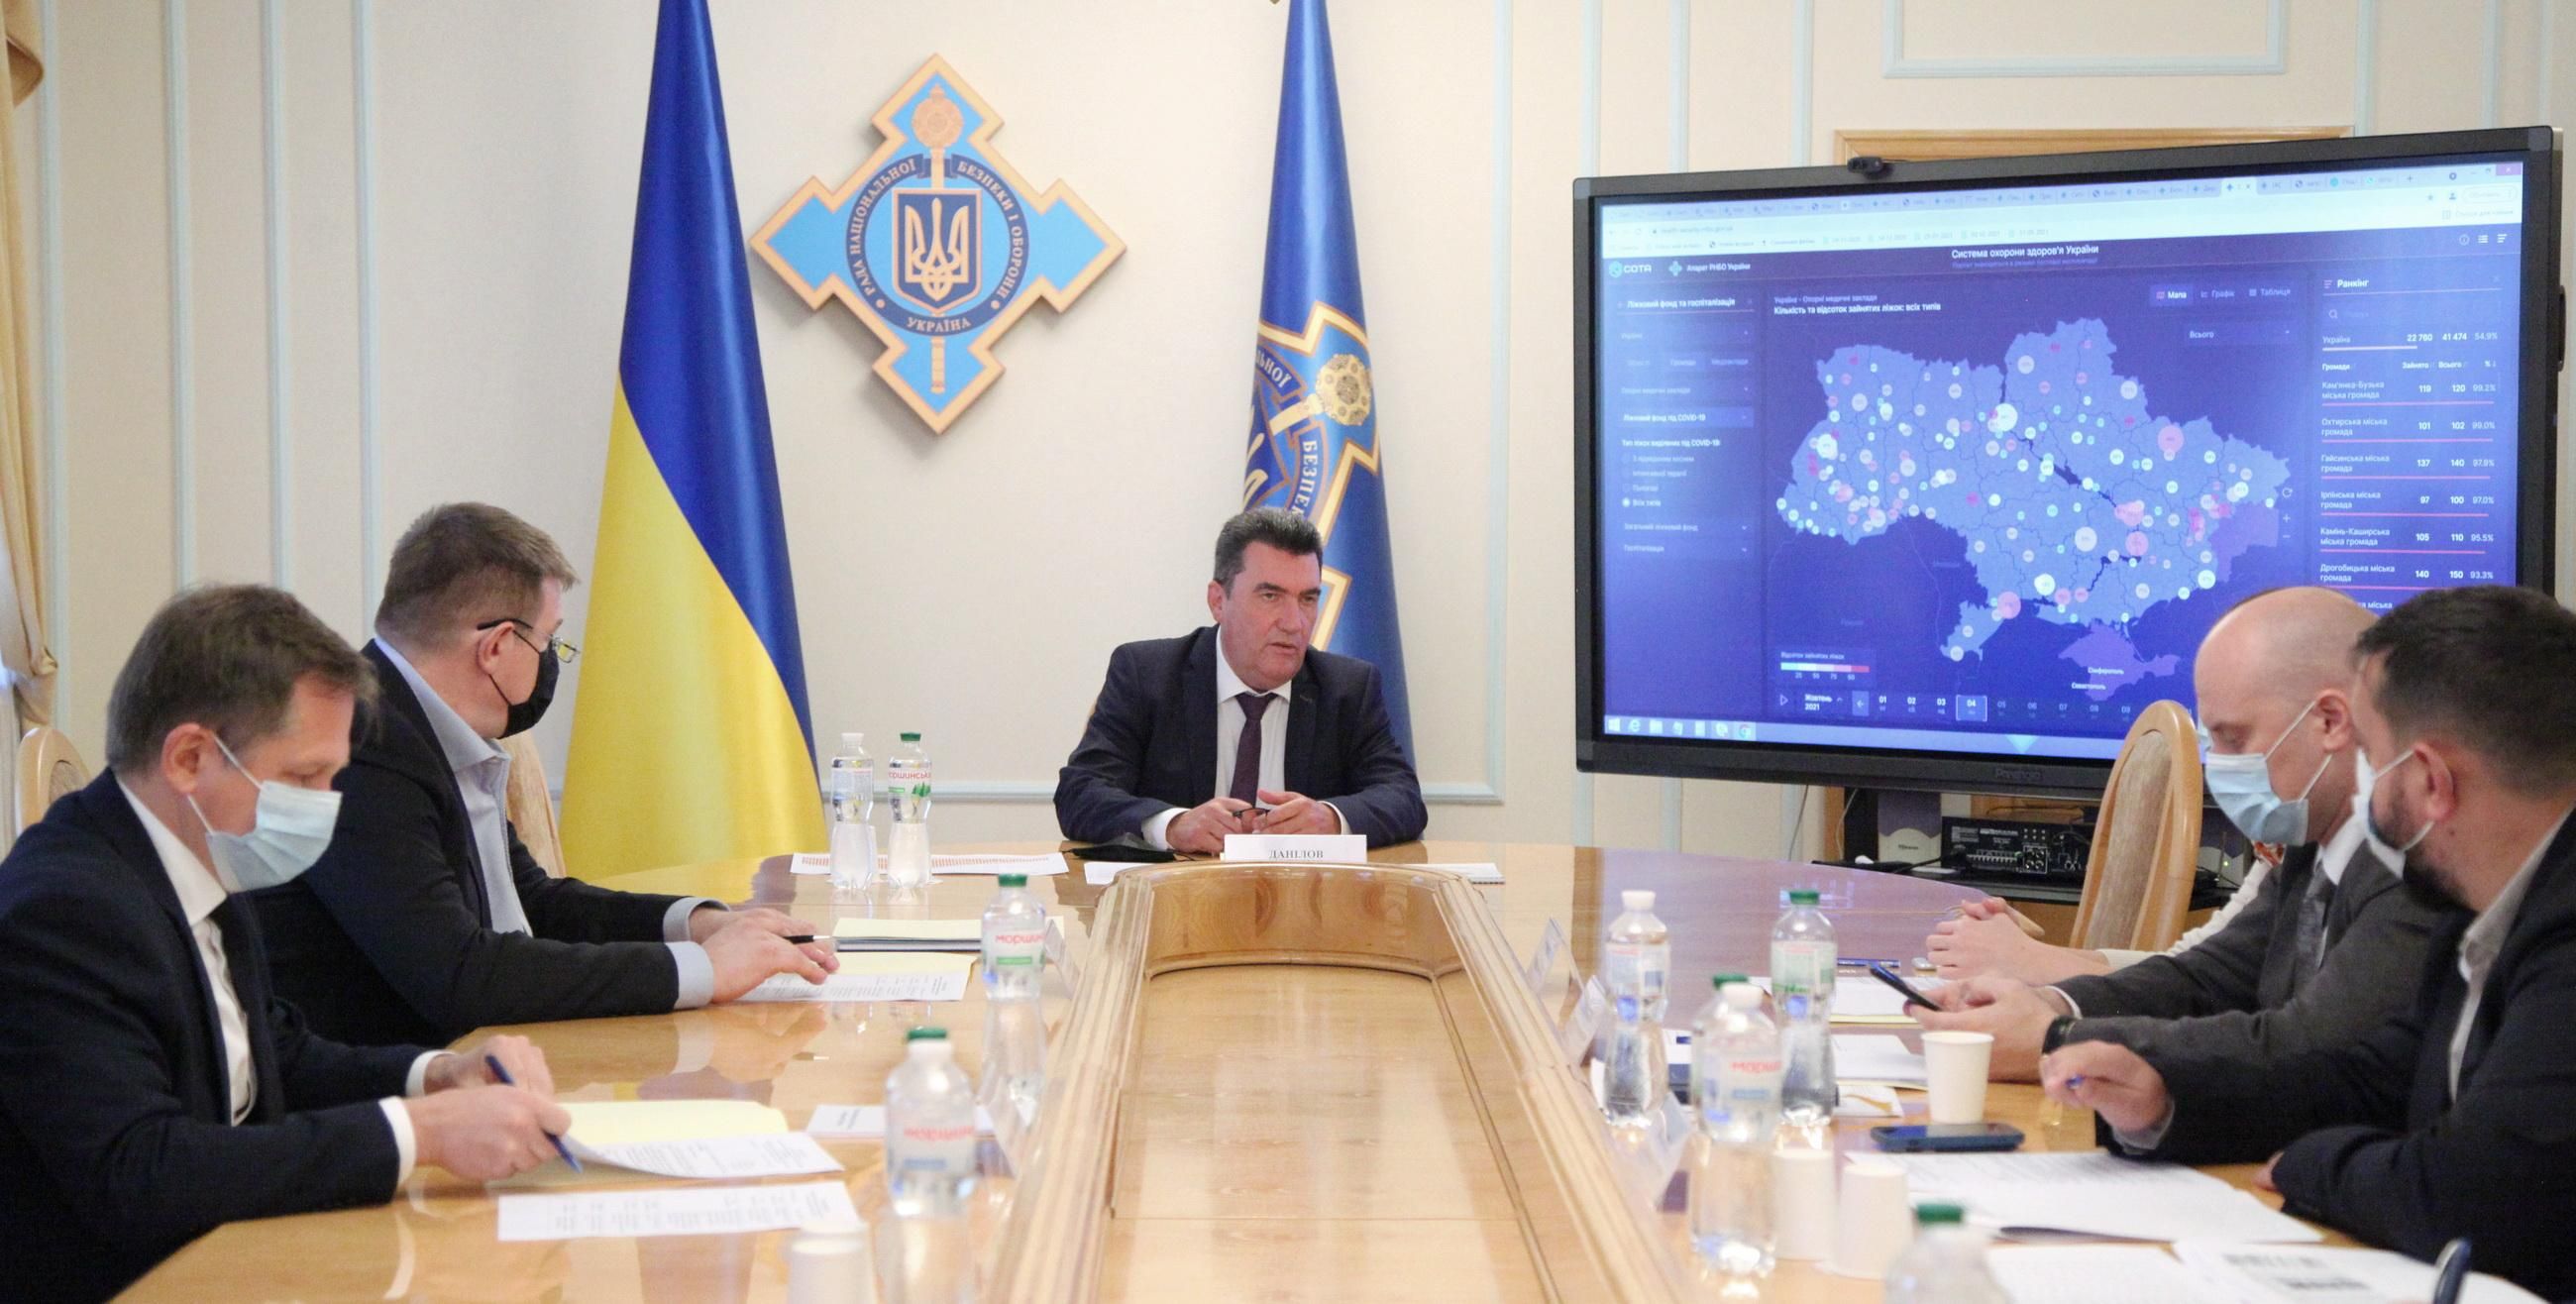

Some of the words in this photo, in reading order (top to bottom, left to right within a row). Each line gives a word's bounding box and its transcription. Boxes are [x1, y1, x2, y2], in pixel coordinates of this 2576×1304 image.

[956, 161, 1016, 211] БЕЗПЕКИ
[849, 158, 916, 256] НАЦІОНАЛЬНОЇ
[1951, 249, 1988, 260] Система
[1989, 249, 2025, 259] охорони
[2026, 246, 2064, 258] здоров'я
[2066, 244, 2099, 256] України
[997, 225, 1024, 299] ОБОРОНИ
[852, 260, 877, 296] РАДА
[2336, 278, 2369, 288] Ранкінг
[2260, 288, 2291, 297] Таблиця
[1660, 299, 1677, 309] фонд
[1773, 305, 1806, 315] Кількість
[1816, 304, 1848, 315] відсоток
[1848, 304, 1880, 313] зайнятих
[1905, 302, 1920, 311] всіх
[1922, 301, 1941, 311] типів
[906, 316, 972, 333] УКРАЇНА
[2189, 330, 2214, 339] Всього
[2322, 335, 2351, 344] Україна
[2347, 391, 2380, 400] громада
[2321, 417, 2361, 426] Охтирська
[2418, 421, 2431, 430] 101
[2451, 421, 2465, 430] 102
[2321, 428, 2353, 437] громада
[2320, 454, 2364, 463] Гайсинська
[2320, 465, 2353, 474] громада
[2419, 495, 2430, 504] 97
[2320, 501, 2353, 510] громада
[2346, 538, 2379, 547] громада
[2319, 564, 2369, 574] Дрогобицька
[2370, 564, 2396, 573] міська
[2319, 574, 2352, 583] громада
[2415, 570, 2429, 579] 140
[2449, 570, 2464, 579] 150
[1936, 698, 1946, 706] 03
[1966, 699, 1977, 707] 04
[1804, 703, 1820, 711] 2021
[2059, 703, 2068, 711] 07
[1269, 849, 1325, 860] ДАНІЛОВ
